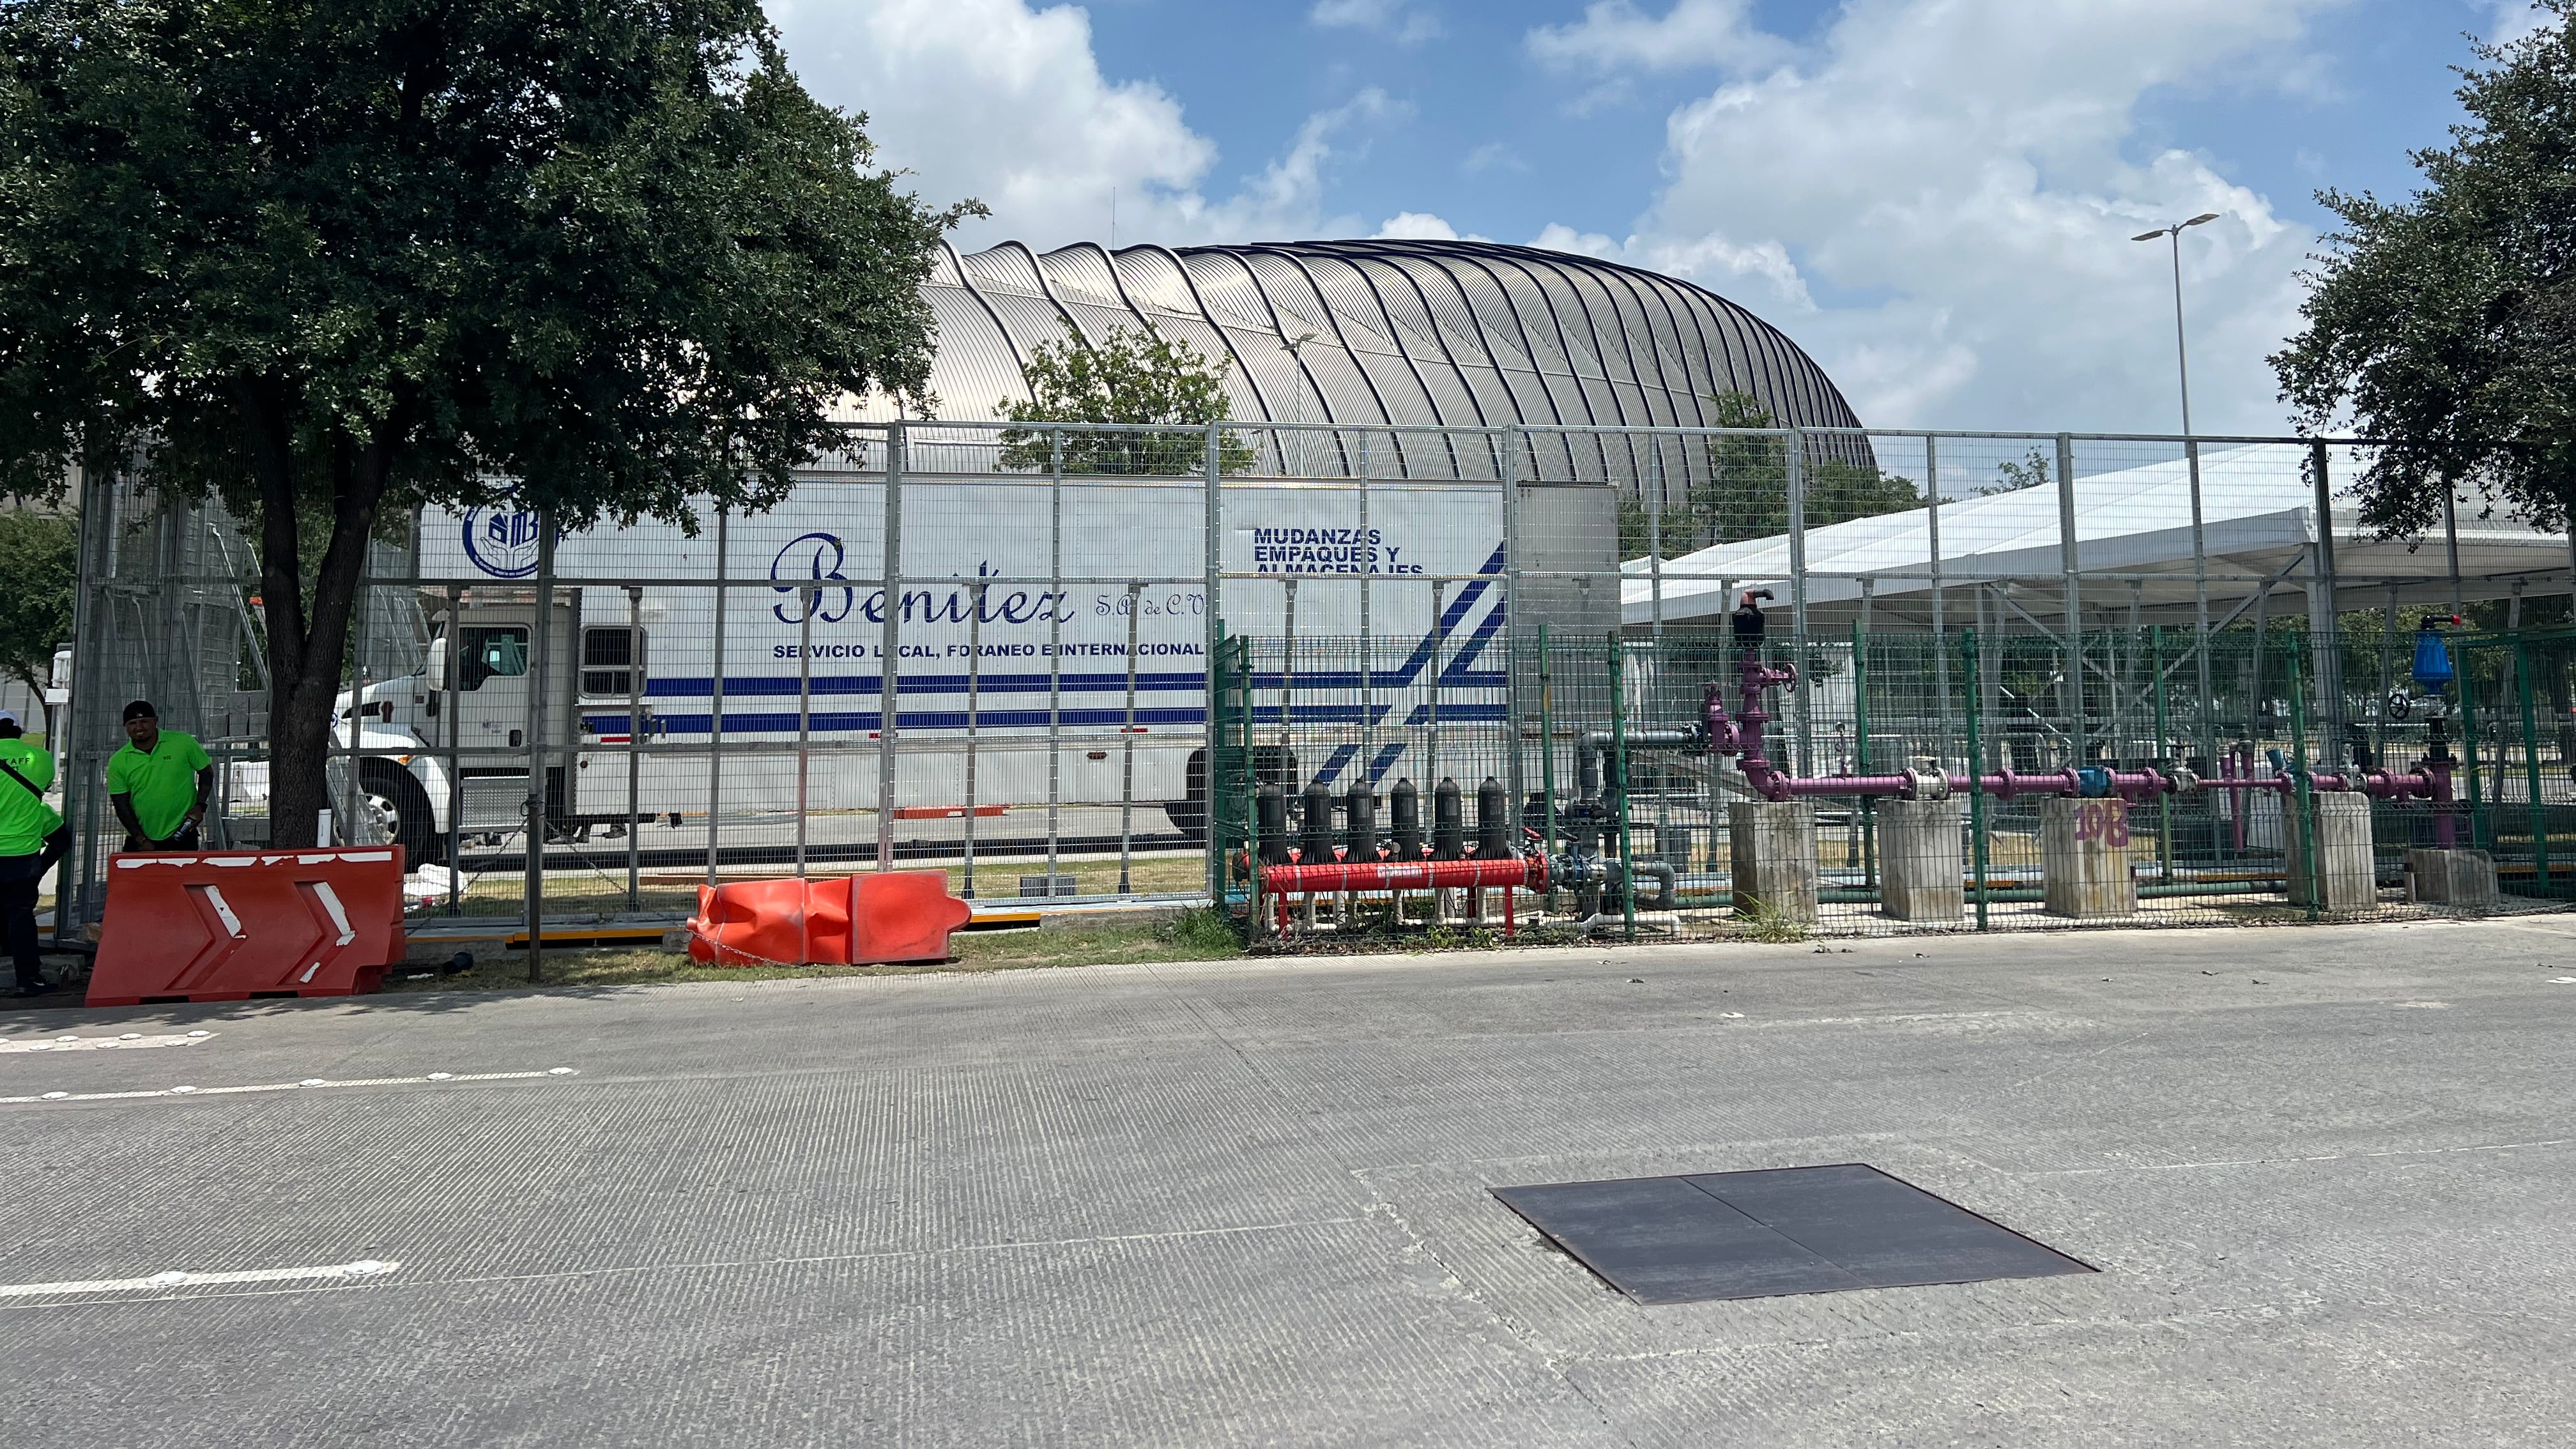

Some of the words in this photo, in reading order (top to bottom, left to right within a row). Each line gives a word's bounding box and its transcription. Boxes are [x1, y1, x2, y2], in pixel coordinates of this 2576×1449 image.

[1254, 528, 1381, 544] MUDANZAS
[1254, 546, 1379, 563] EMPAQUES
[1384, 547, 1401, 562] Y
[770, 532, 1075, 624] Benitez
[1144, 600, 1162, 615] de
[873, 645, 941, 660] LCAL,
[947, 643, 1035, 657] FORANEO
[1041, 644, 1052, 656] E
